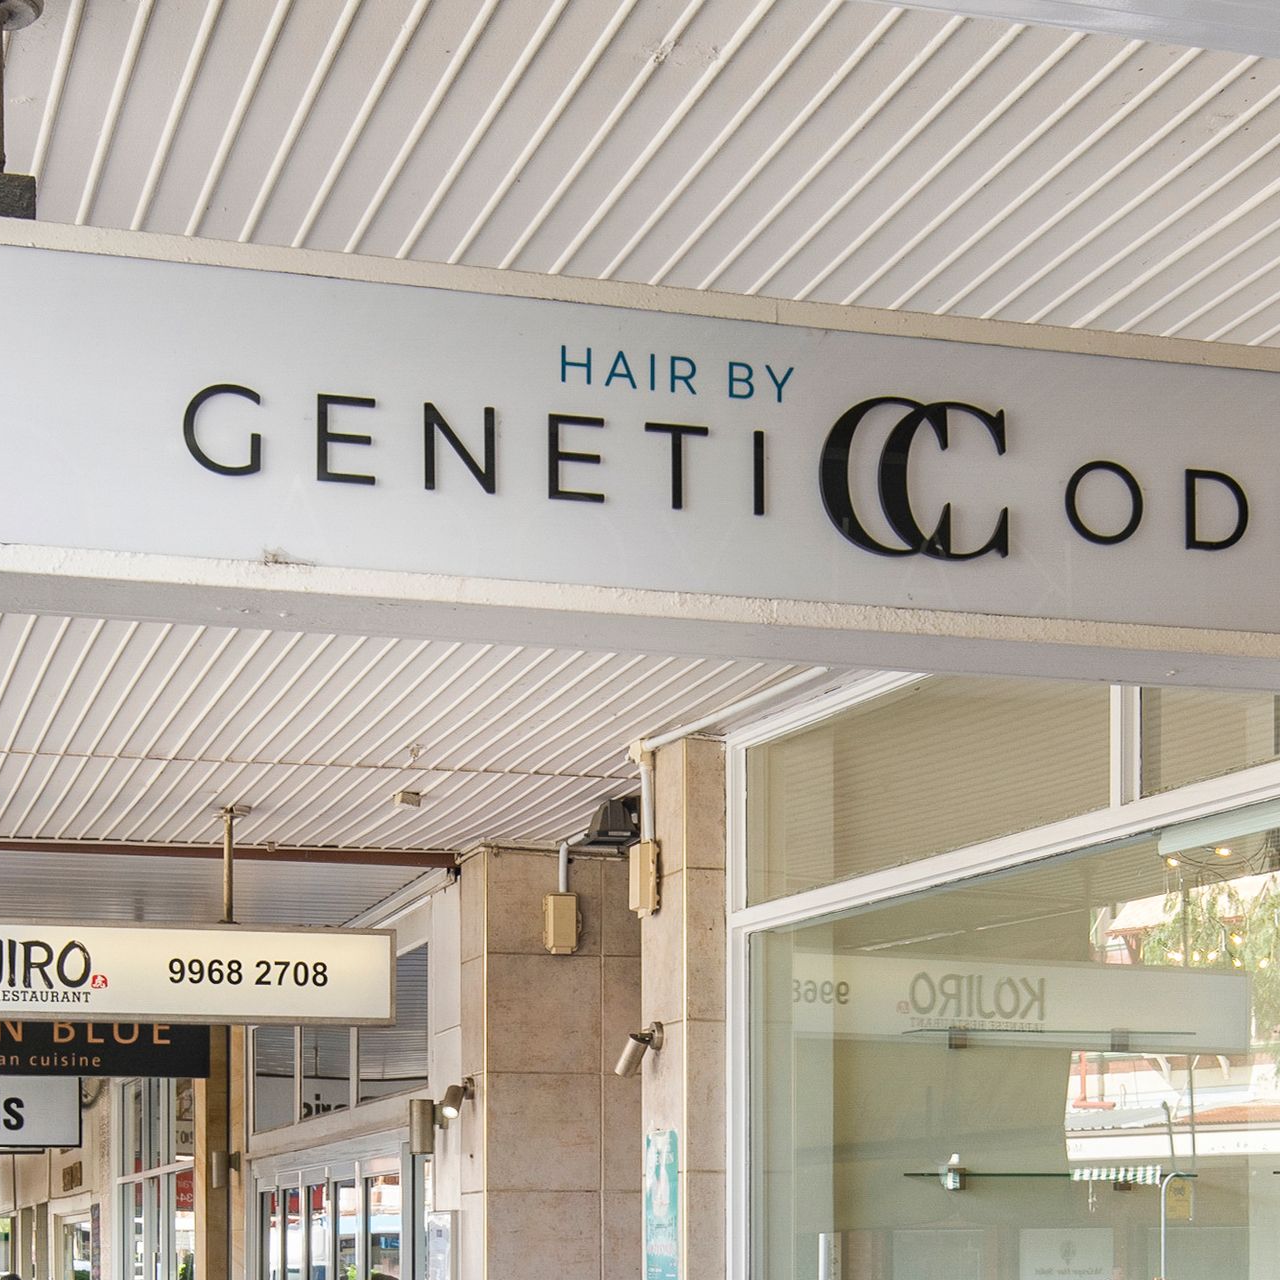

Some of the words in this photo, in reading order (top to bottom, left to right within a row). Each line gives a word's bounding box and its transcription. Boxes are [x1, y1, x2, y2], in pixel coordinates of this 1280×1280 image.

[560, 344, 699, 398] HAIR
[727, 364, 796, 404] BY
[168, 958, 244, 985] 9968
[255, 960, 329, 988] 2708
[52, 1021, 172, 1046] BLUE
[29, 1053, 102, 1069] cuisine
